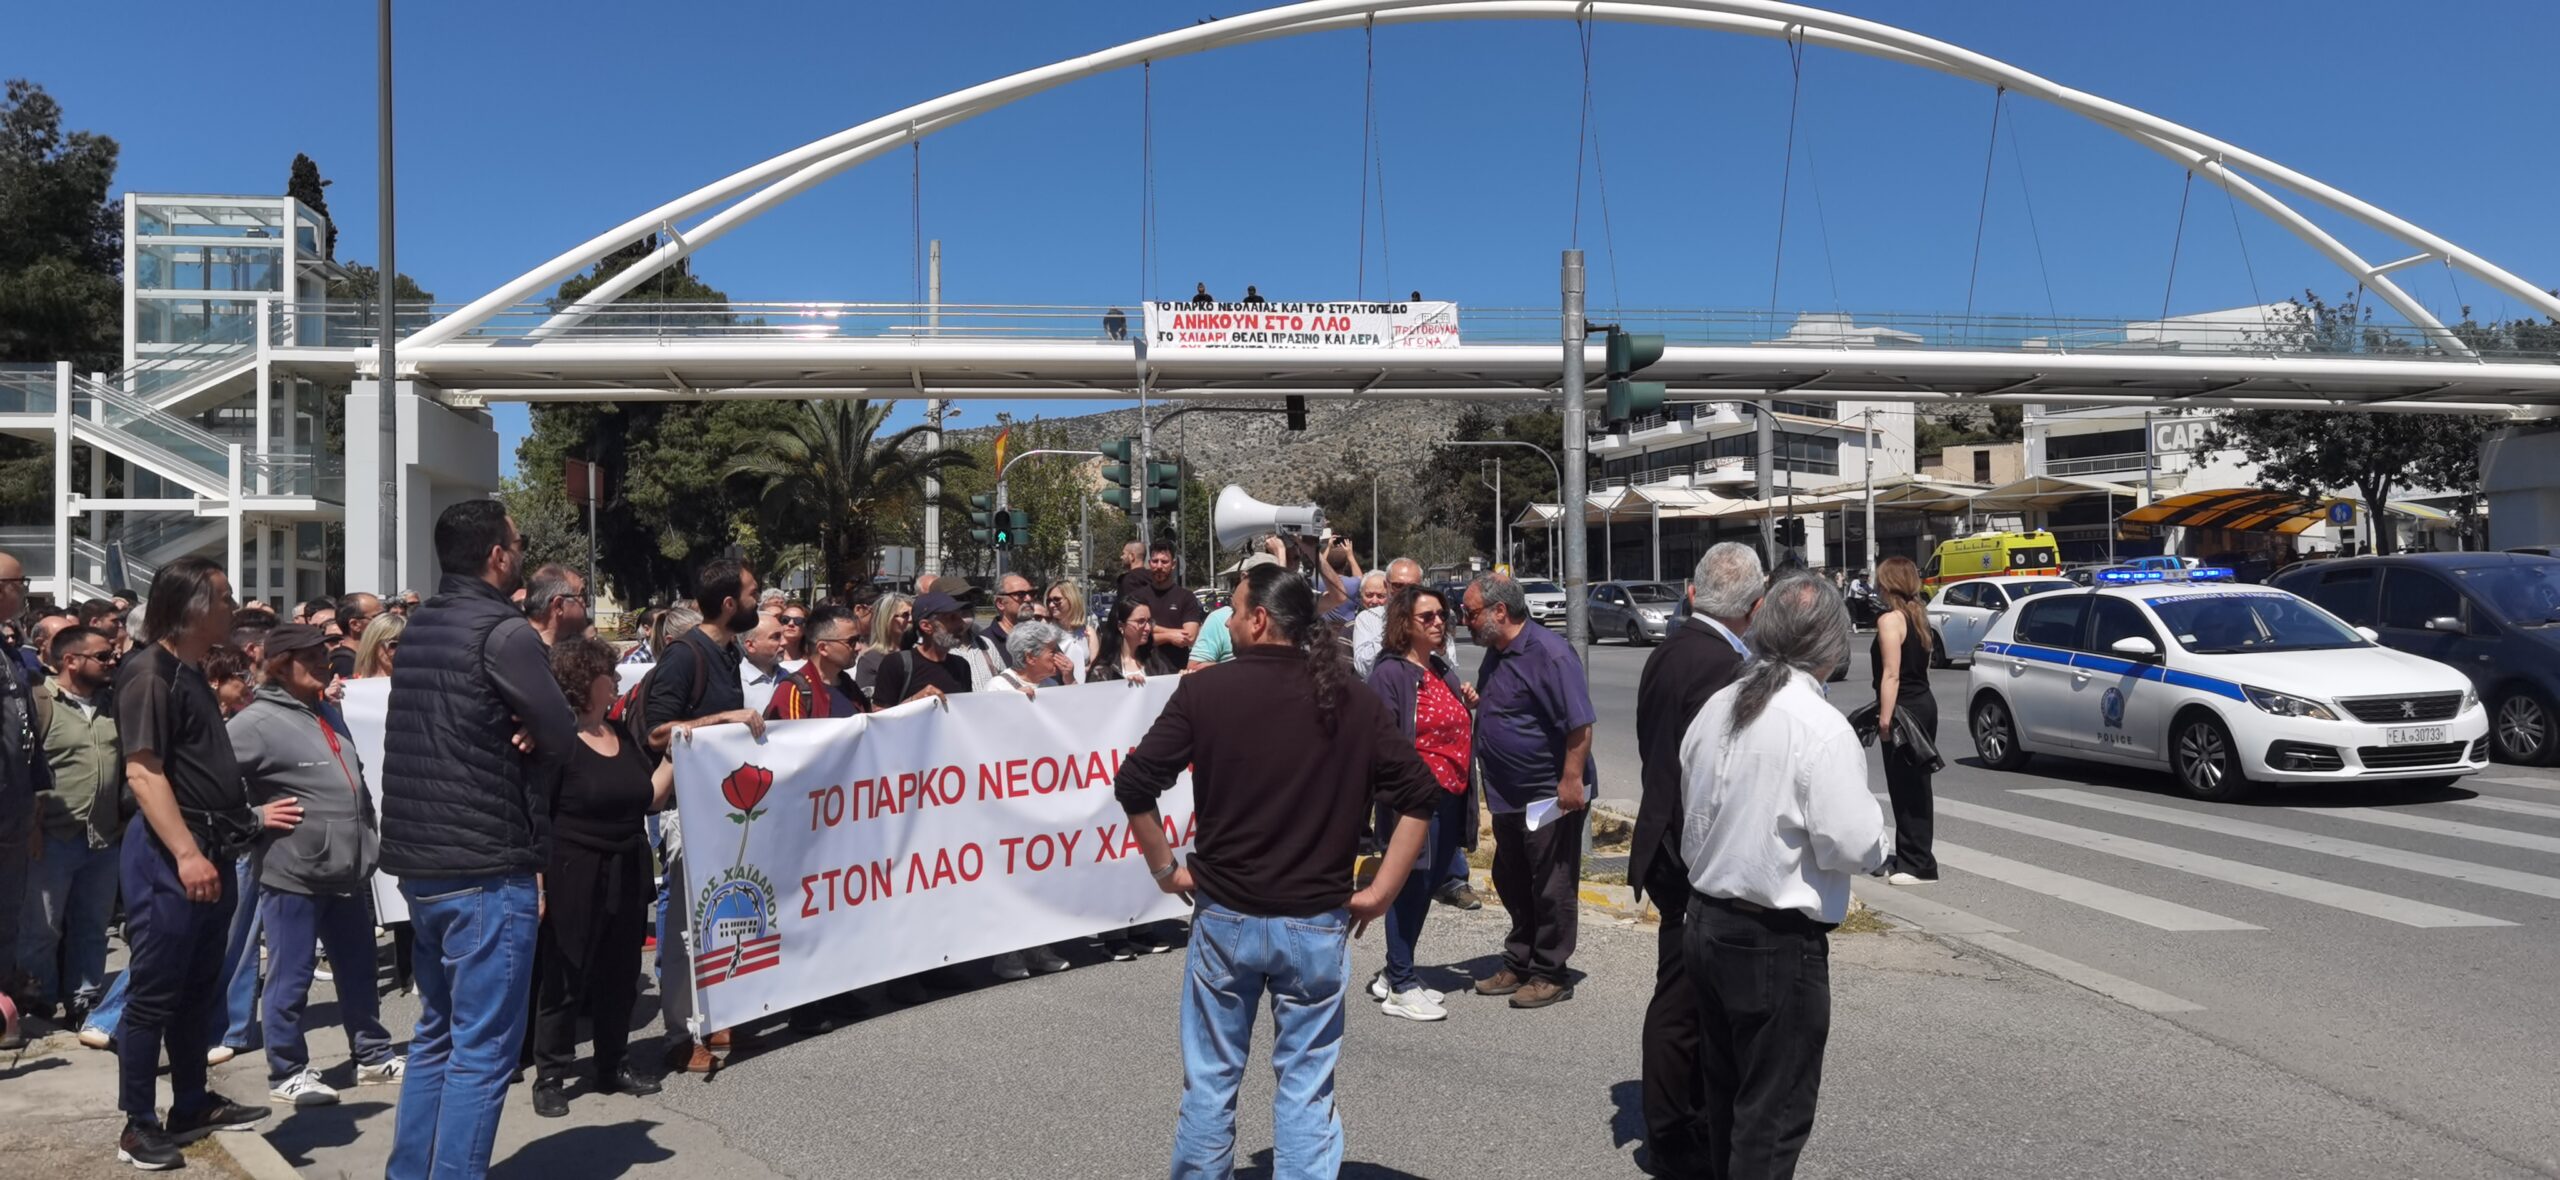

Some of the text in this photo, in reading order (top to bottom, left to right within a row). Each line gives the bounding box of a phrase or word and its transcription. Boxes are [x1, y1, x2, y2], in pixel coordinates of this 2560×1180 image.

[1155, 302, 1408, 314] ΤΟ ΠΑΡΚΟ ΝΕΟΛΑΙΑΣ ΚΑΙ ΤΟ ΣΤΡΑΤΟΠΕΔΟ
[1173, 314, 1351, 331] ΑΝΗΚΟΥΝ ΣΤΟ ΛΑΟ
[1159, 331, 1380, 345] ΤΟ ΧΑΙΔΑΡΙ ΘΕΛΕΙ ΠΡΑΣΙΝΟ ΚΑΙ ΑΕΡΑ
[2097, 732, 2133, 745] POLICE
[2415, 727, 2440, 742] 30733
[808, 746, 1137, 832] ΤΟ ΠΑΡΚΟ ΝΕΟΛΑΙ
[801, 858, 892, 918] ΣΤΟΝ
[906, 842, 983, 894] ΛΑΟ
[999, 829, 1082, 875] ΤΟΥ
[693, 876, 719, 949] ΔΗΜΟΣ
